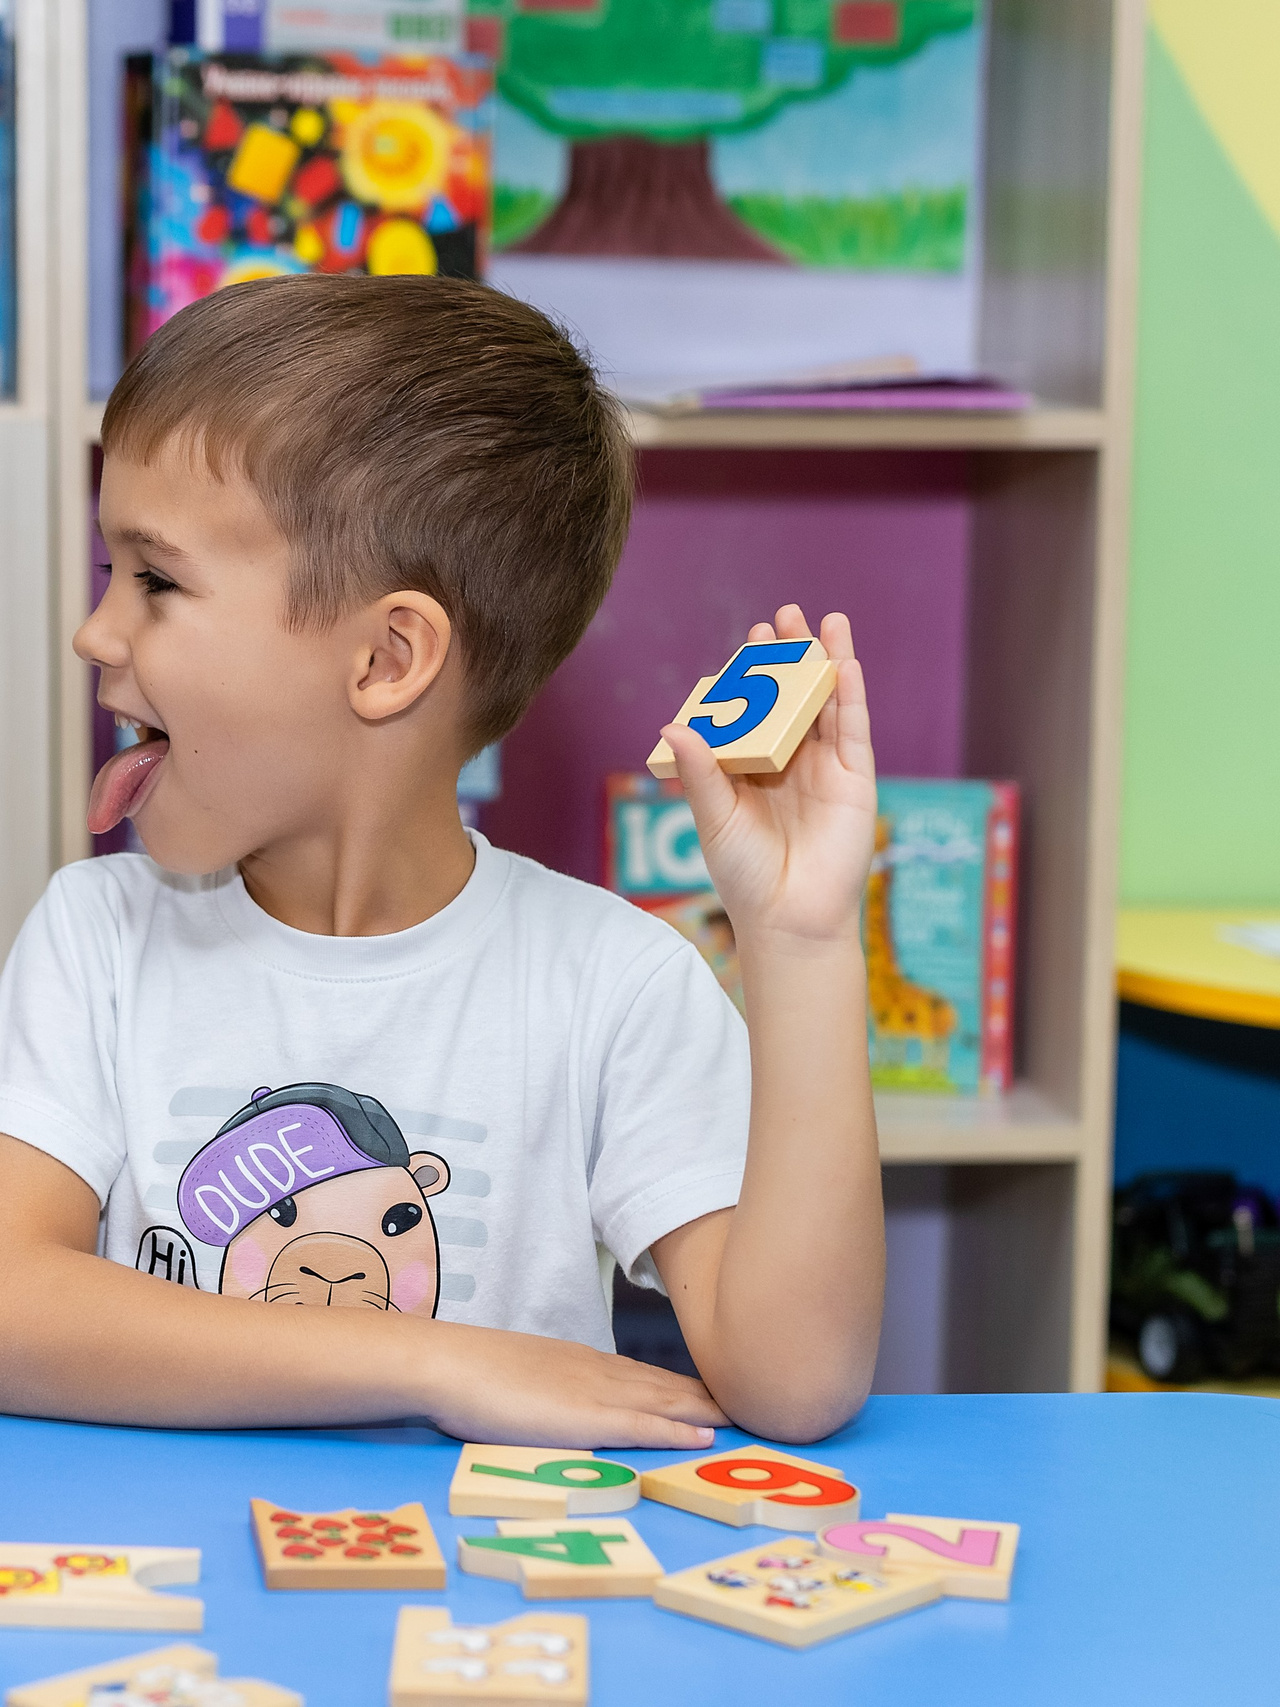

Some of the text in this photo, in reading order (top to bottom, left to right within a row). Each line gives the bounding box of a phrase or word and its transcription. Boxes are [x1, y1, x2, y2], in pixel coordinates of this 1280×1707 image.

[687, 641, 813, 748] 5
[194, 1122, 335, 1235] DUDE
[148, 1231, 187, 1285] Hi
[462, 1531, 628, 1565] 4
[823, 1522, 1000, 1567] 2
